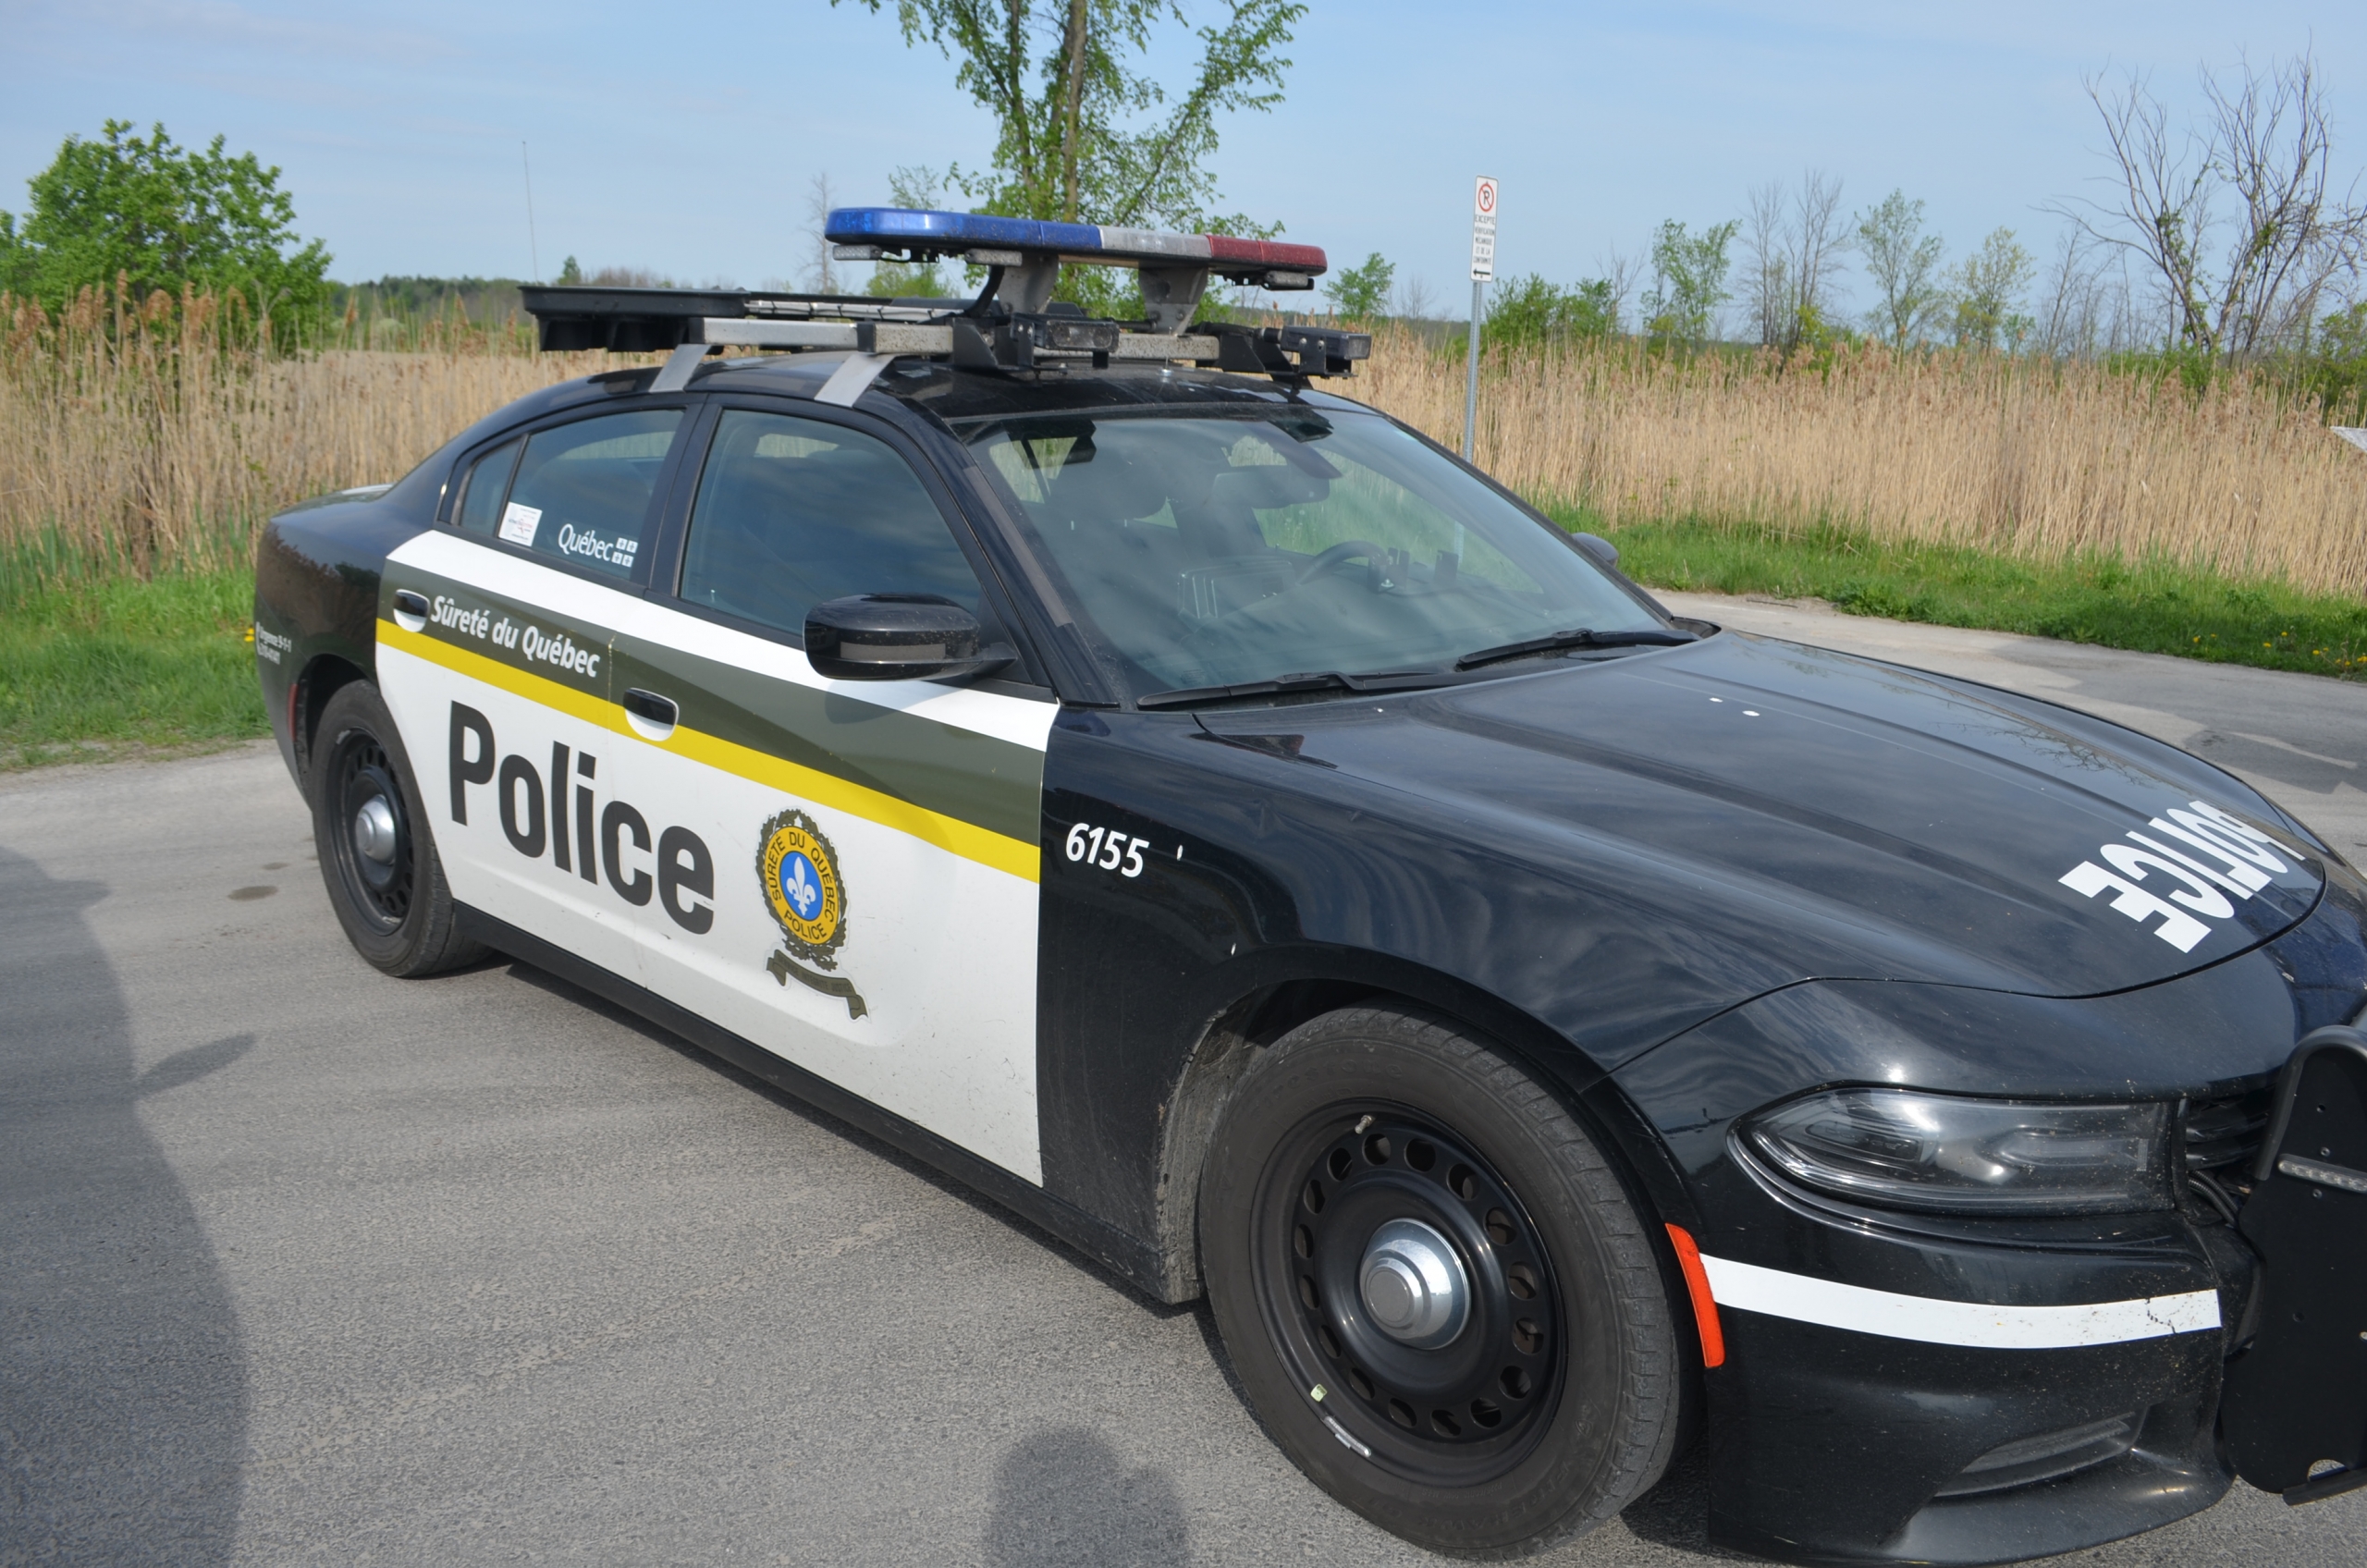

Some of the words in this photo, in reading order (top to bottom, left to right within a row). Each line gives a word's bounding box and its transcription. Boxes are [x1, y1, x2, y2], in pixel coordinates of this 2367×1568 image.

[558, 522, 614, 562] Québec
[430, 594, 491, 640] Sûreté
[491, 617, 520, 649] du
[521, 625, 601, 678] Québec
[449, 699, 715, 935] Police
[788, 831, 805, 849] DU
[1065, 822, 1150, 878] 6155
[783, 909, 828, 940] POLICE
